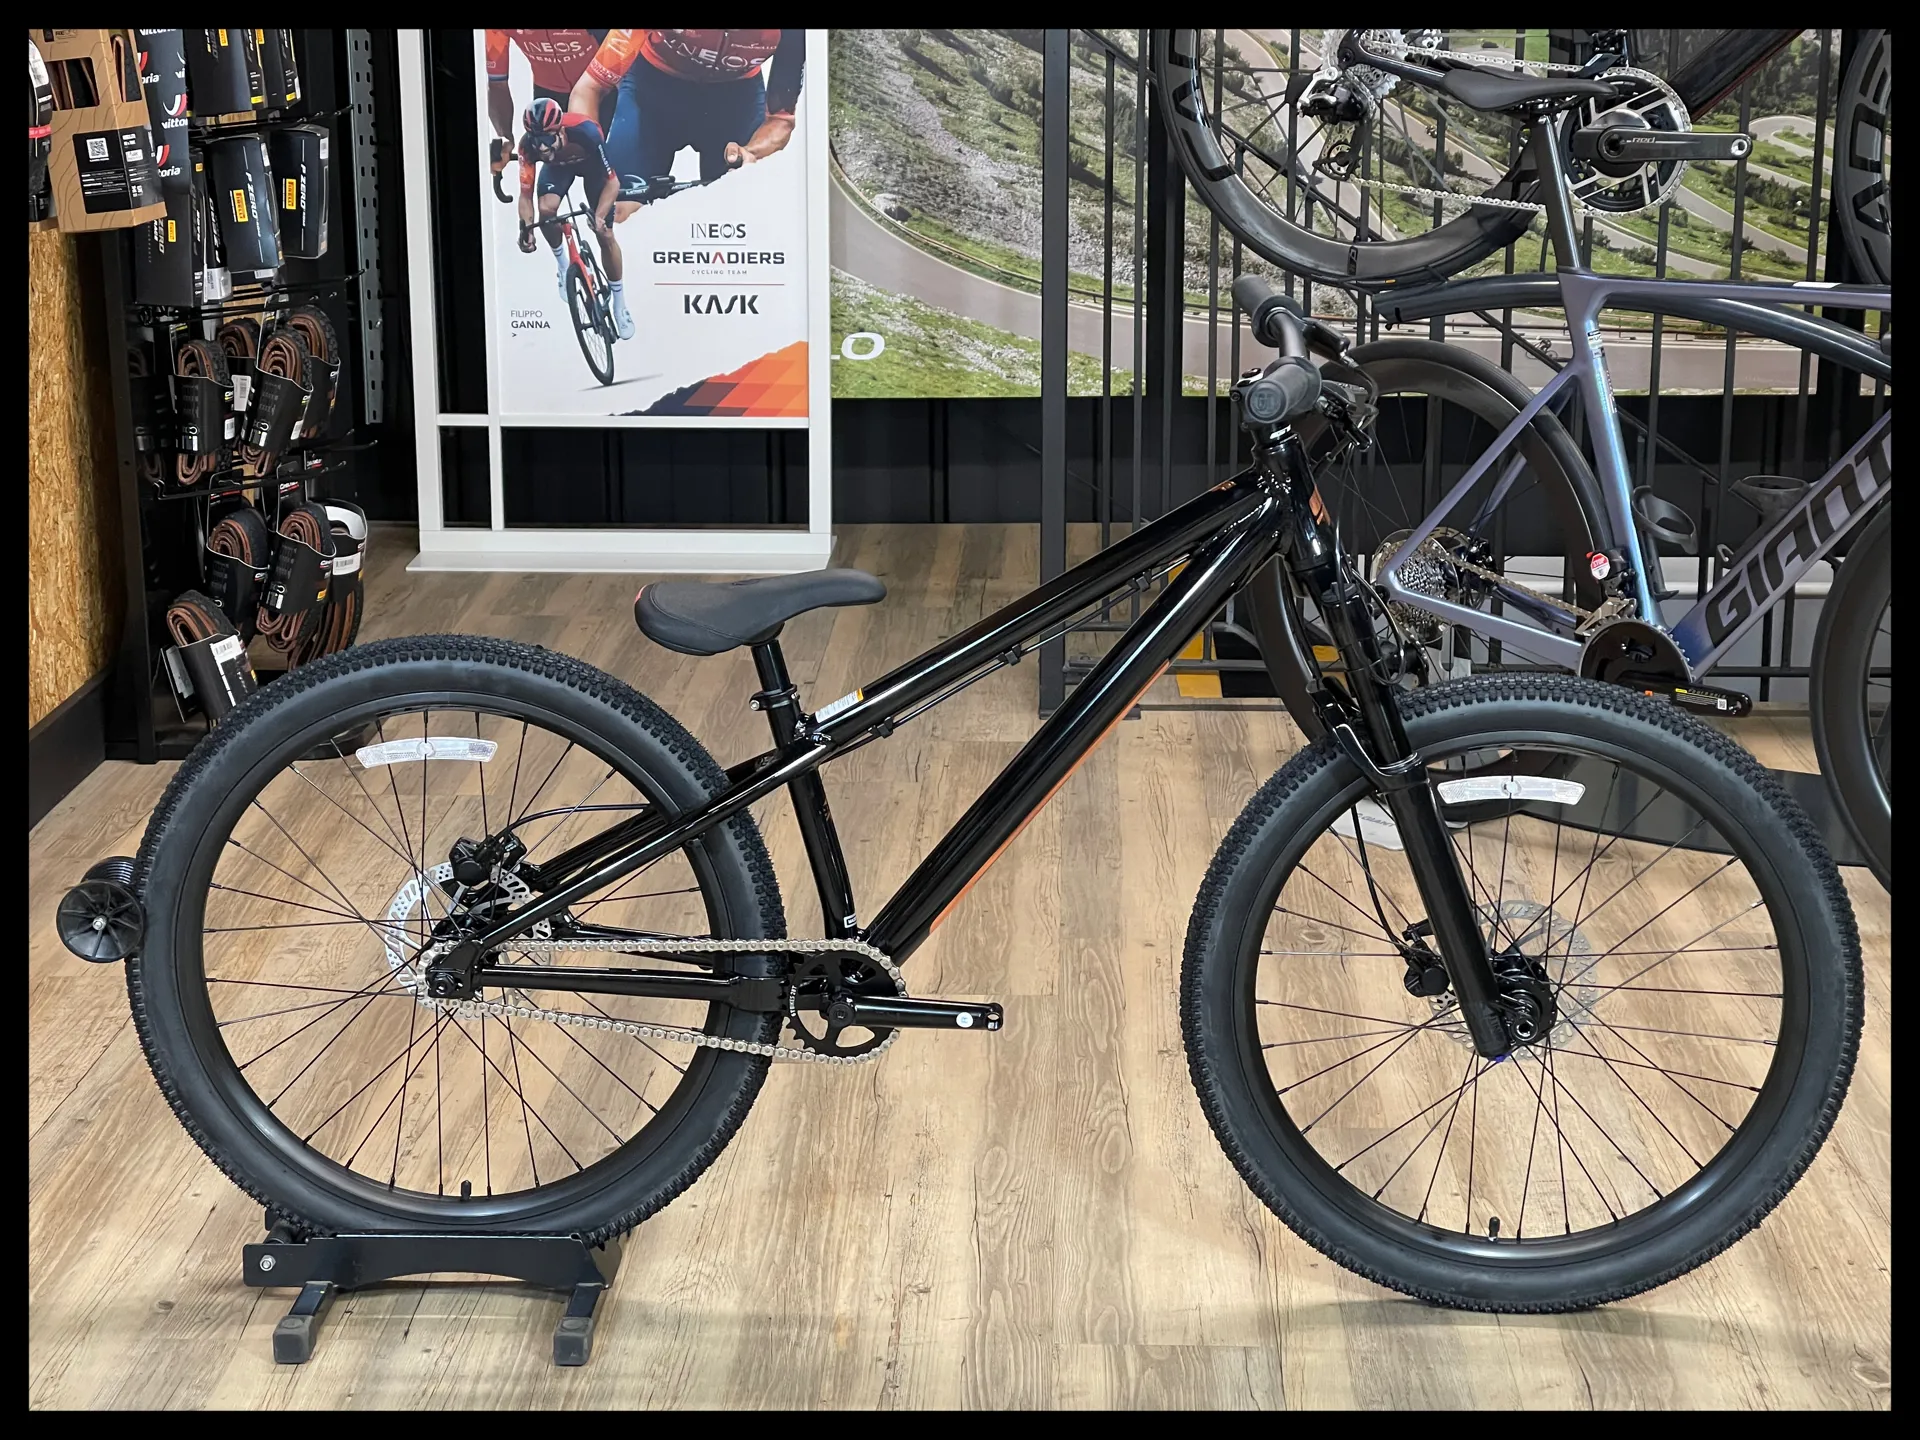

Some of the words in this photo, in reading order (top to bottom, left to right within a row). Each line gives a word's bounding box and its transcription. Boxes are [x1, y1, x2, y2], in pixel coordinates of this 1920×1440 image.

[523, 41, 582, 53] INEOS
[247, 182, 258, 219] ZERO
[691, 223, 747, 239] INEOS
[652, 251, 785, 265] GRENADIERS
[684, 294, 760, 315] KASK
[510, 310, 543, 318] FILIPPO
[510, 320, 551, 329] GANNA
[830, 331, 885, 360] O
[1705, 418, 1891, 649] GIANT
